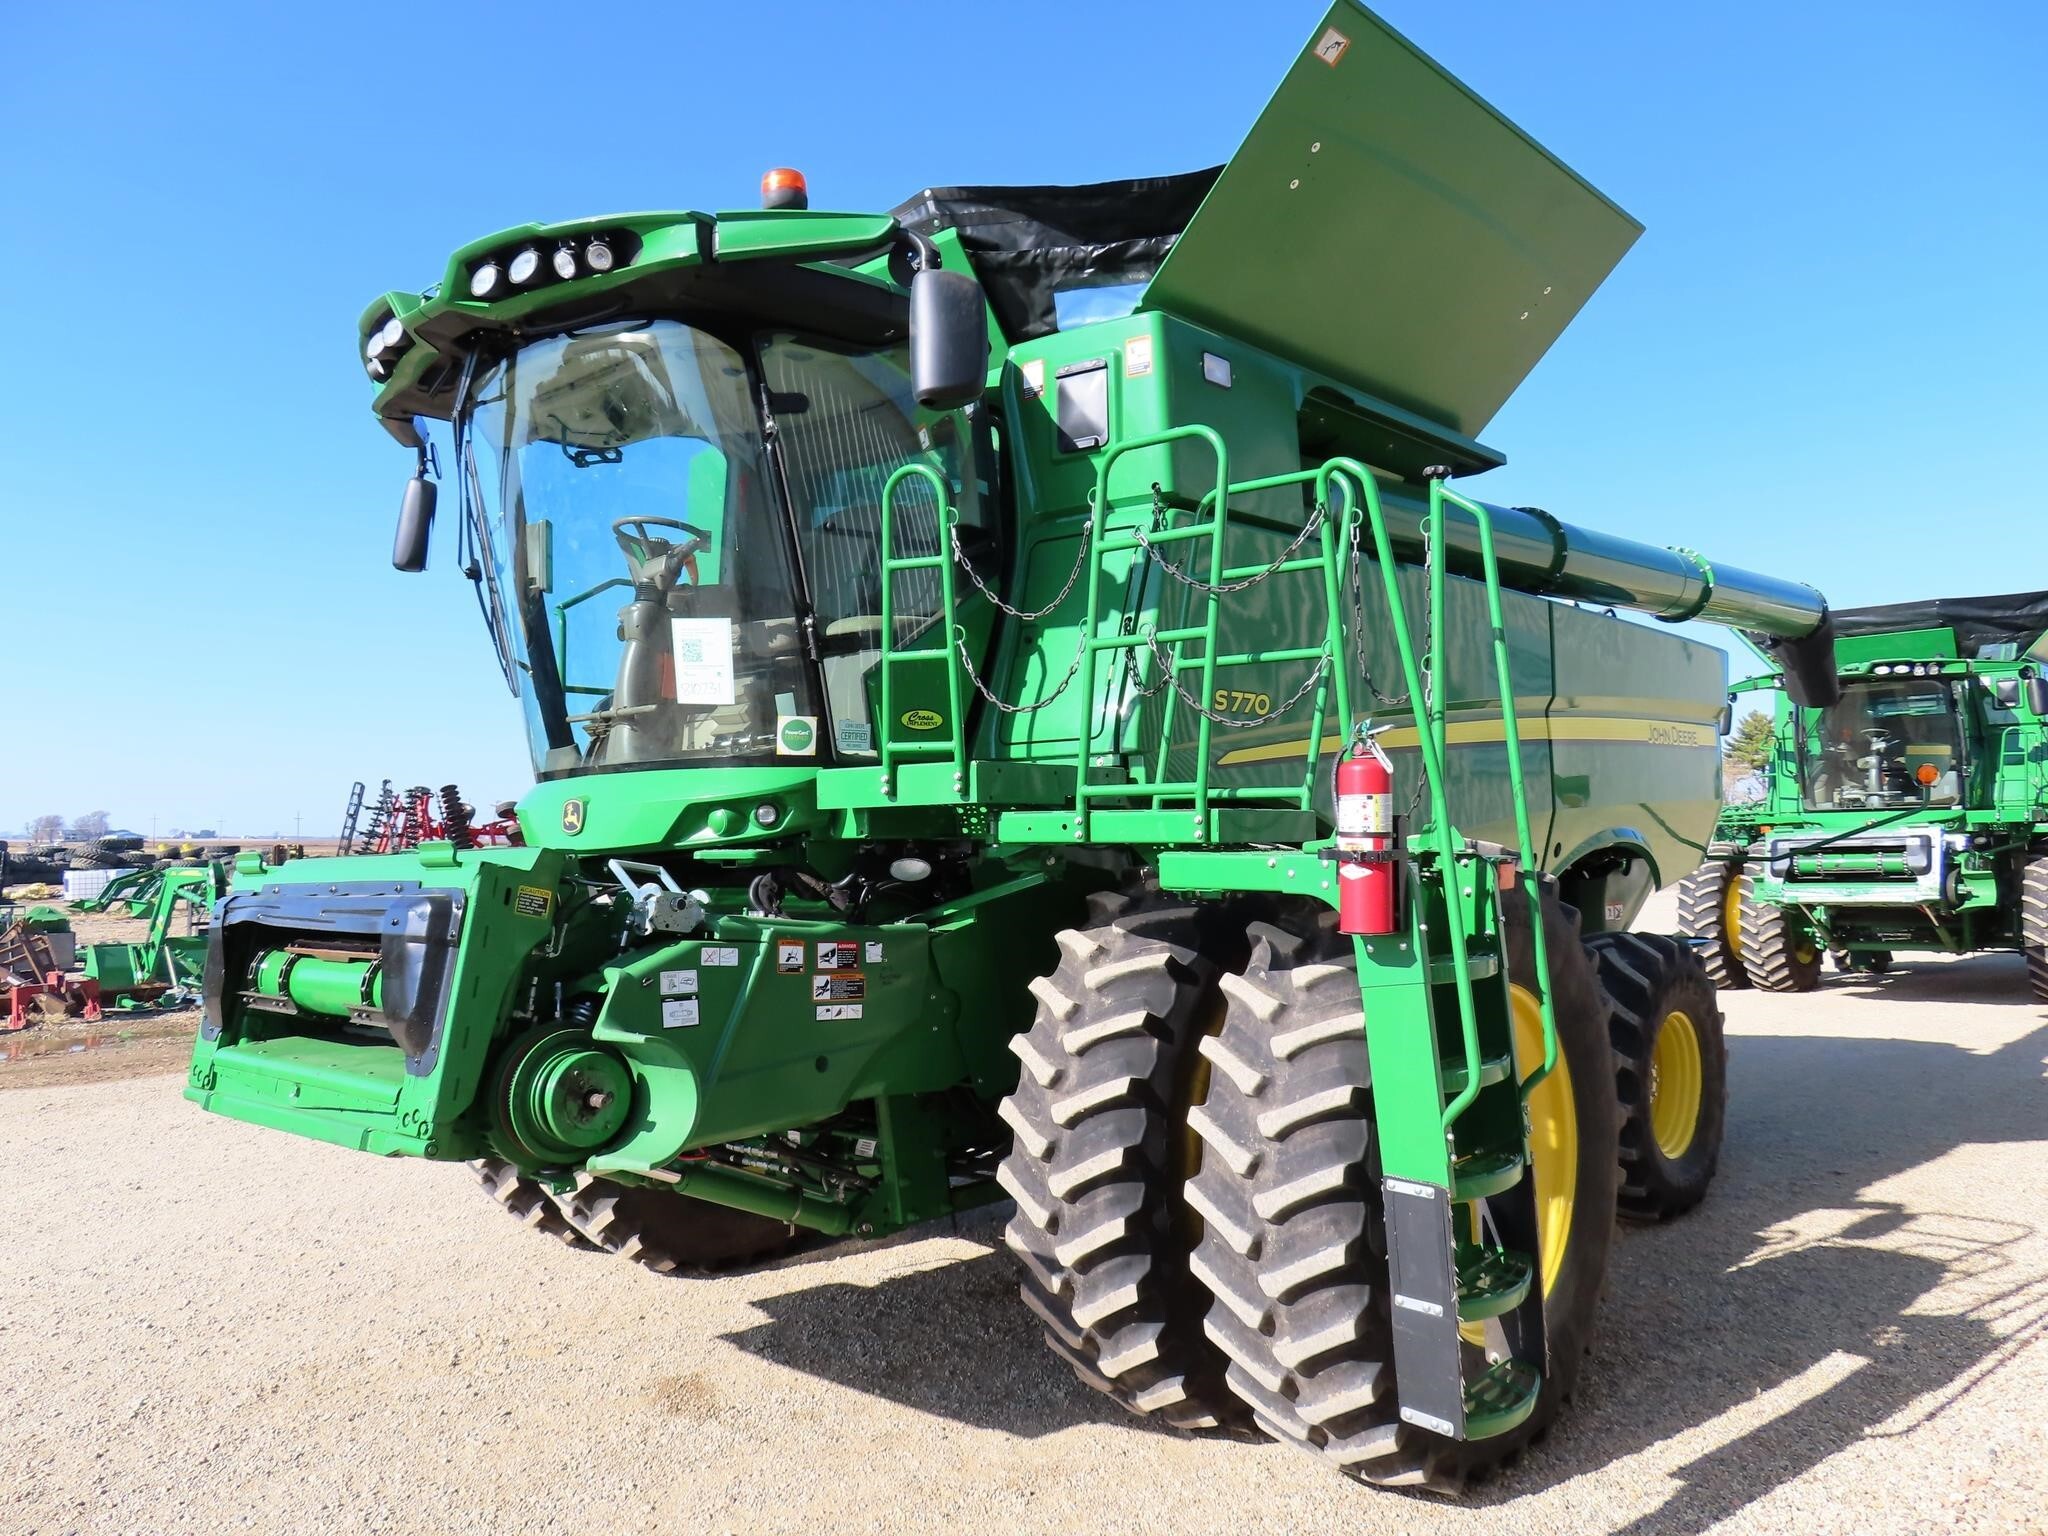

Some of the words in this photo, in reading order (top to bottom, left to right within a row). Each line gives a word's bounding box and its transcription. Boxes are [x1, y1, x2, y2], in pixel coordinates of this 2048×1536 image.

[1214, 689, 1228, 711] S
[1231, 690, 1270, 715] 770
[908, 711, 934, 722] Cross
[841, 731, 867, 740] CERTIFIED
[1647, 724, 1671, 743] JOHN
[1672, 726, 1698, 744] DEERE
